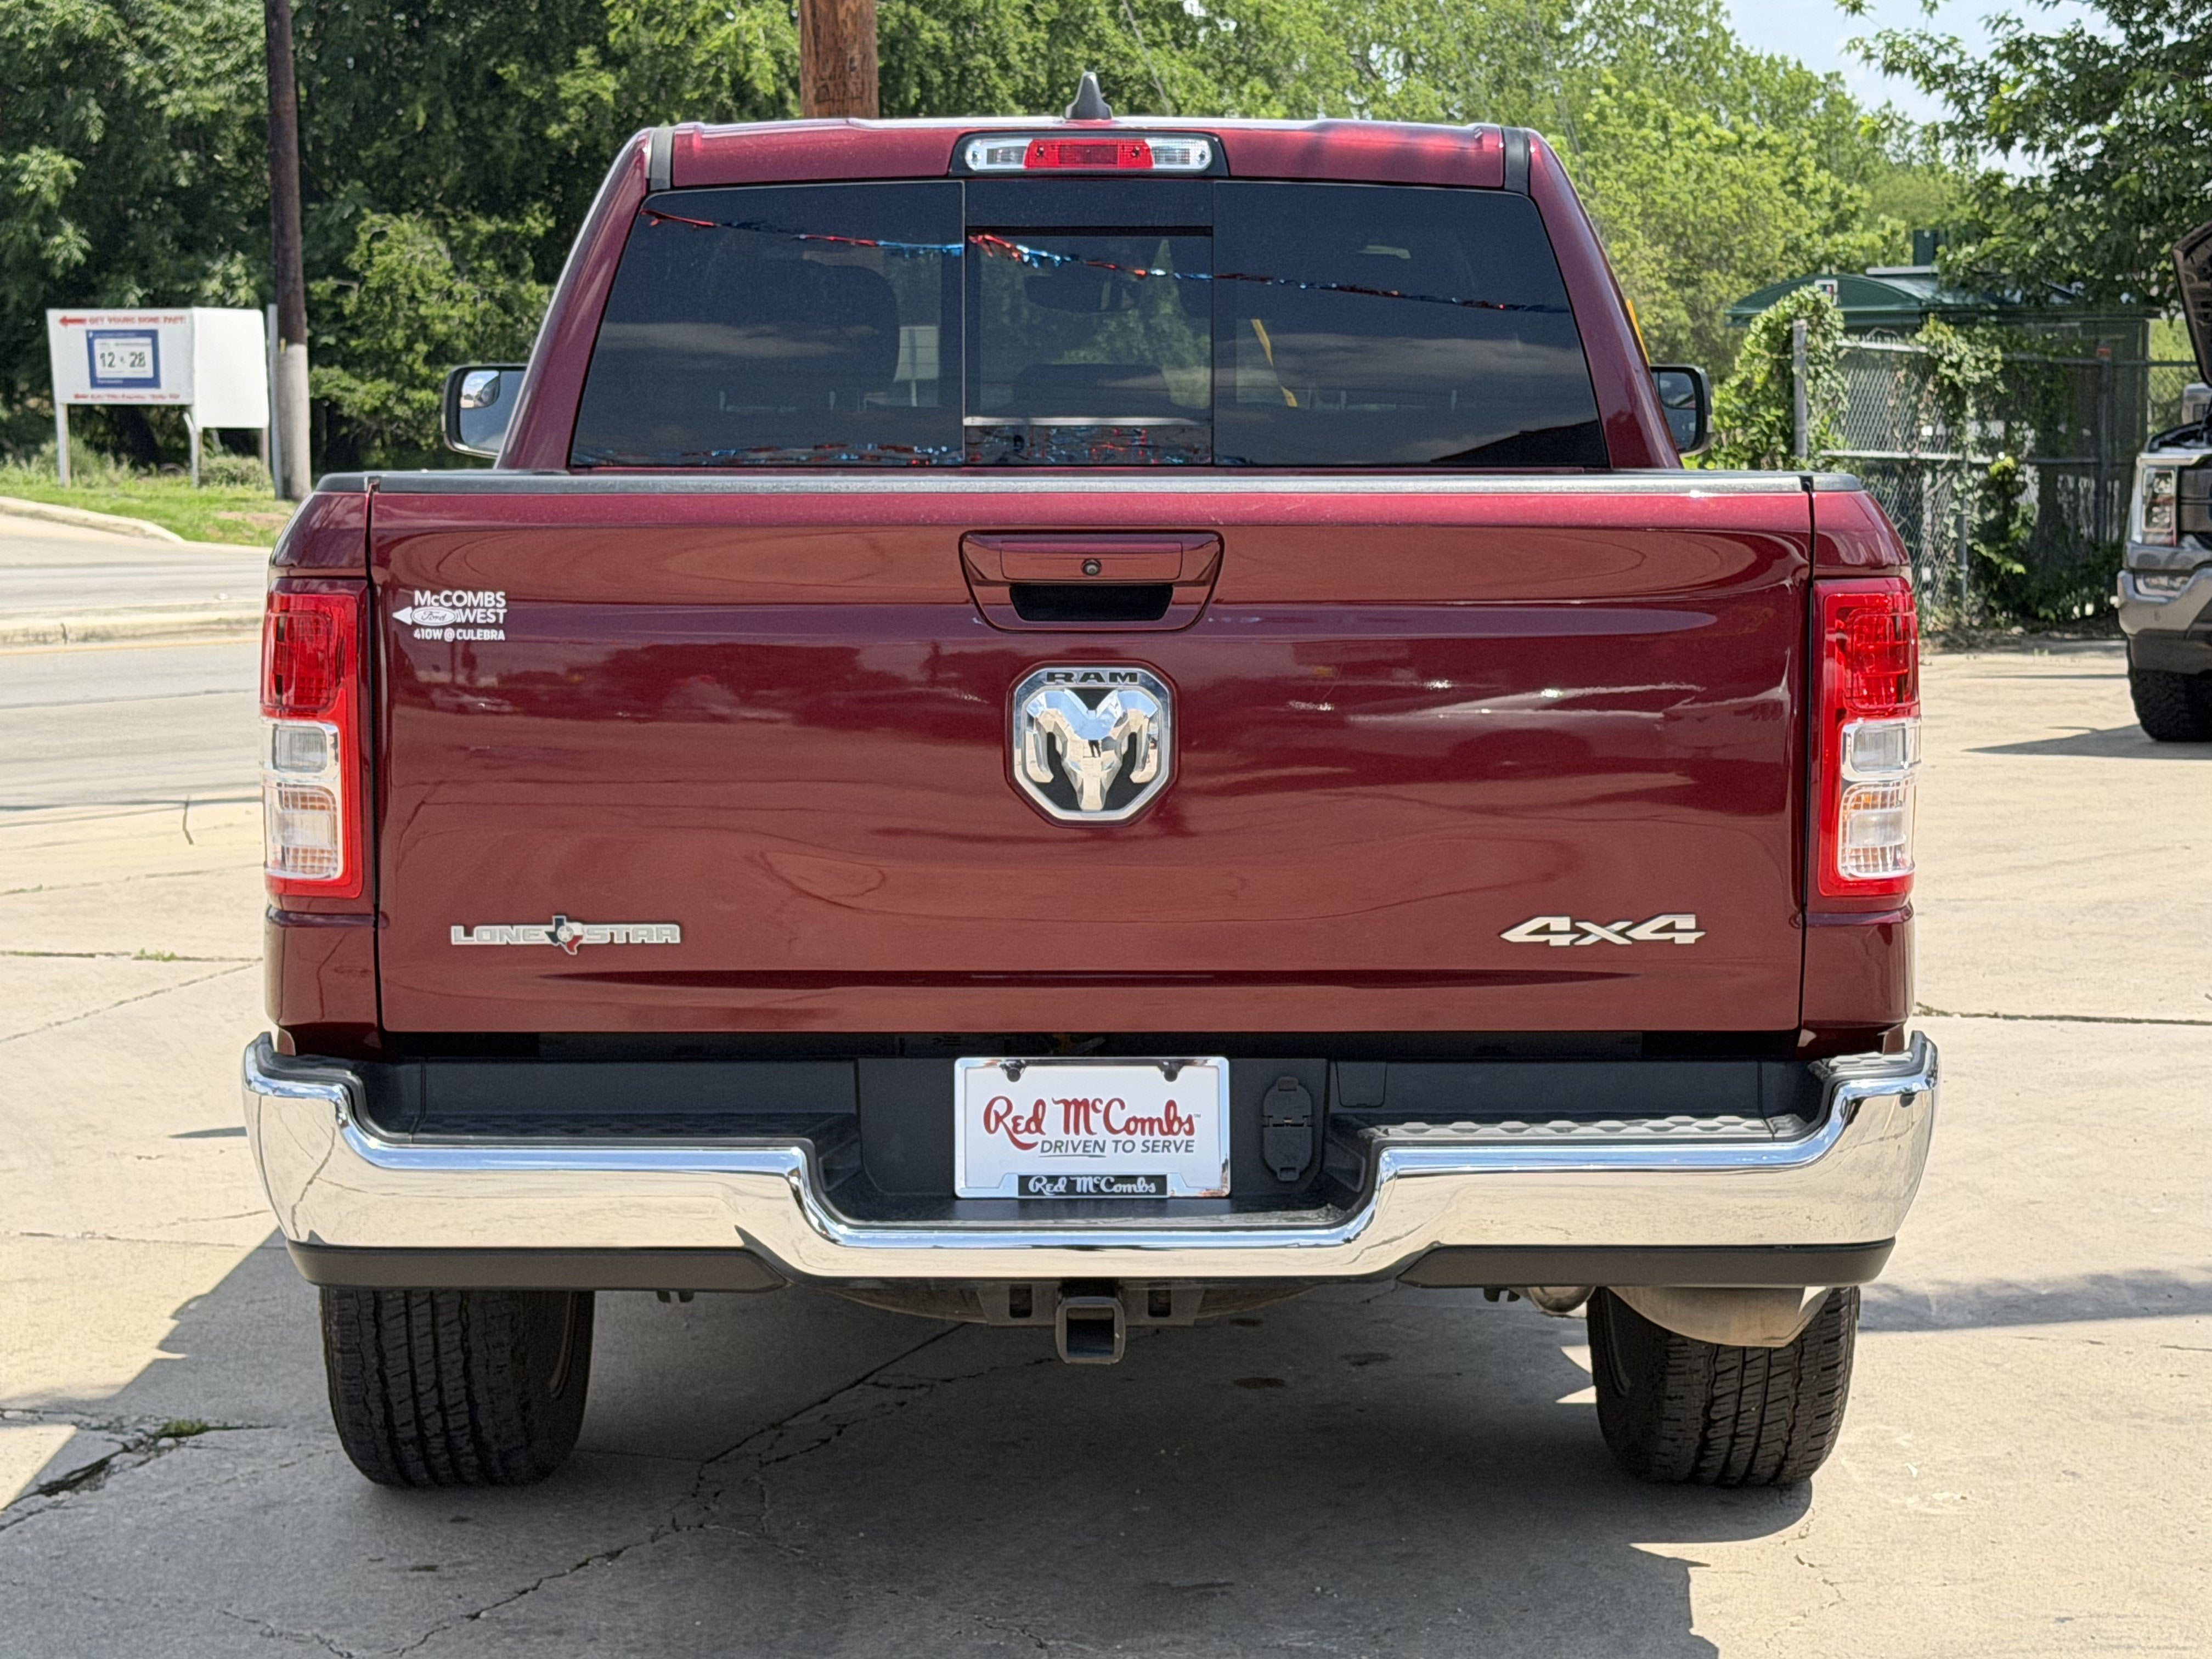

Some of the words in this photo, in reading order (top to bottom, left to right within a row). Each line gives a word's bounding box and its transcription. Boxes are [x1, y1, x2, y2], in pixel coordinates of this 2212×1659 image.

[99, 352, 116, 369] 12
[129, 352, 146, 368] 28
[414, 590, 506, 607] McCOMBS
[420, 611, 447, 622] Ford
[459, 608, 507, 624] WEST
[1046, 672, 1138, 683] RAM
[451, 925, 545, 945] LONE
[585, 924, 681, 944] STAR
[983, 1096, 1046, 1150] Red
[1052, 1097, 1194, 1136] McCombs
[1039, 1139, 1106, 1153] DRIVEN
[1112, 1139, 1136, 1153] TO
[1141, 1139, 1195, 1153] SERVE
[1028, 1175, 1068, 1195] Red
[1070, 1176, 1156, 1194] McCombs
